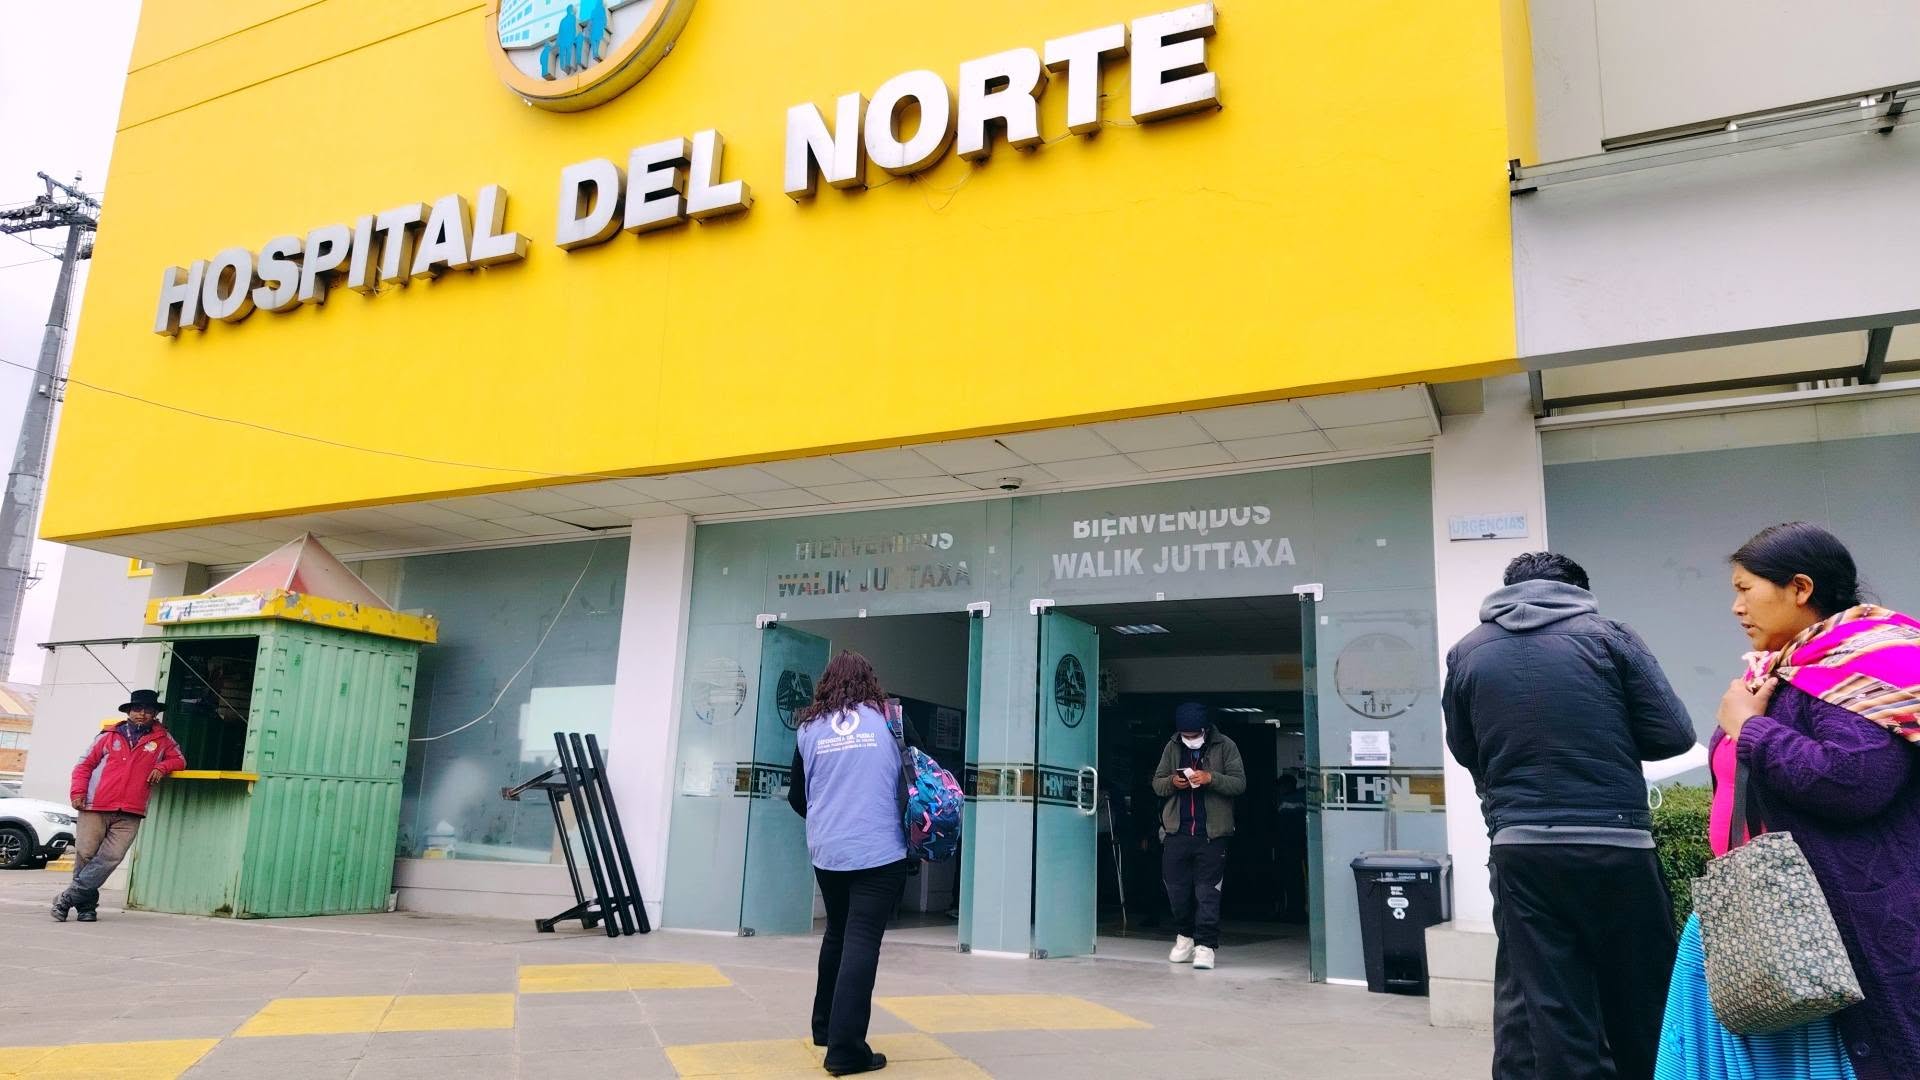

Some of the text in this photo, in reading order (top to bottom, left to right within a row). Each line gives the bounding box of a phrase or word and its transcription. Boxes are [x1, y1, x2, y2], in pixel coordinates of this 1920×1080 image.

[153, 3, 1221, 337] HOSPITAL DEL NORTE
[1073, 504, 1272, 542] BIENVENIDOS
[1451, 516, 1526, 533] URGENCIAS
[1052, 537, 1297, 581] WALIK JUTTAXA
[777, 569, 850, 598] WALIK
